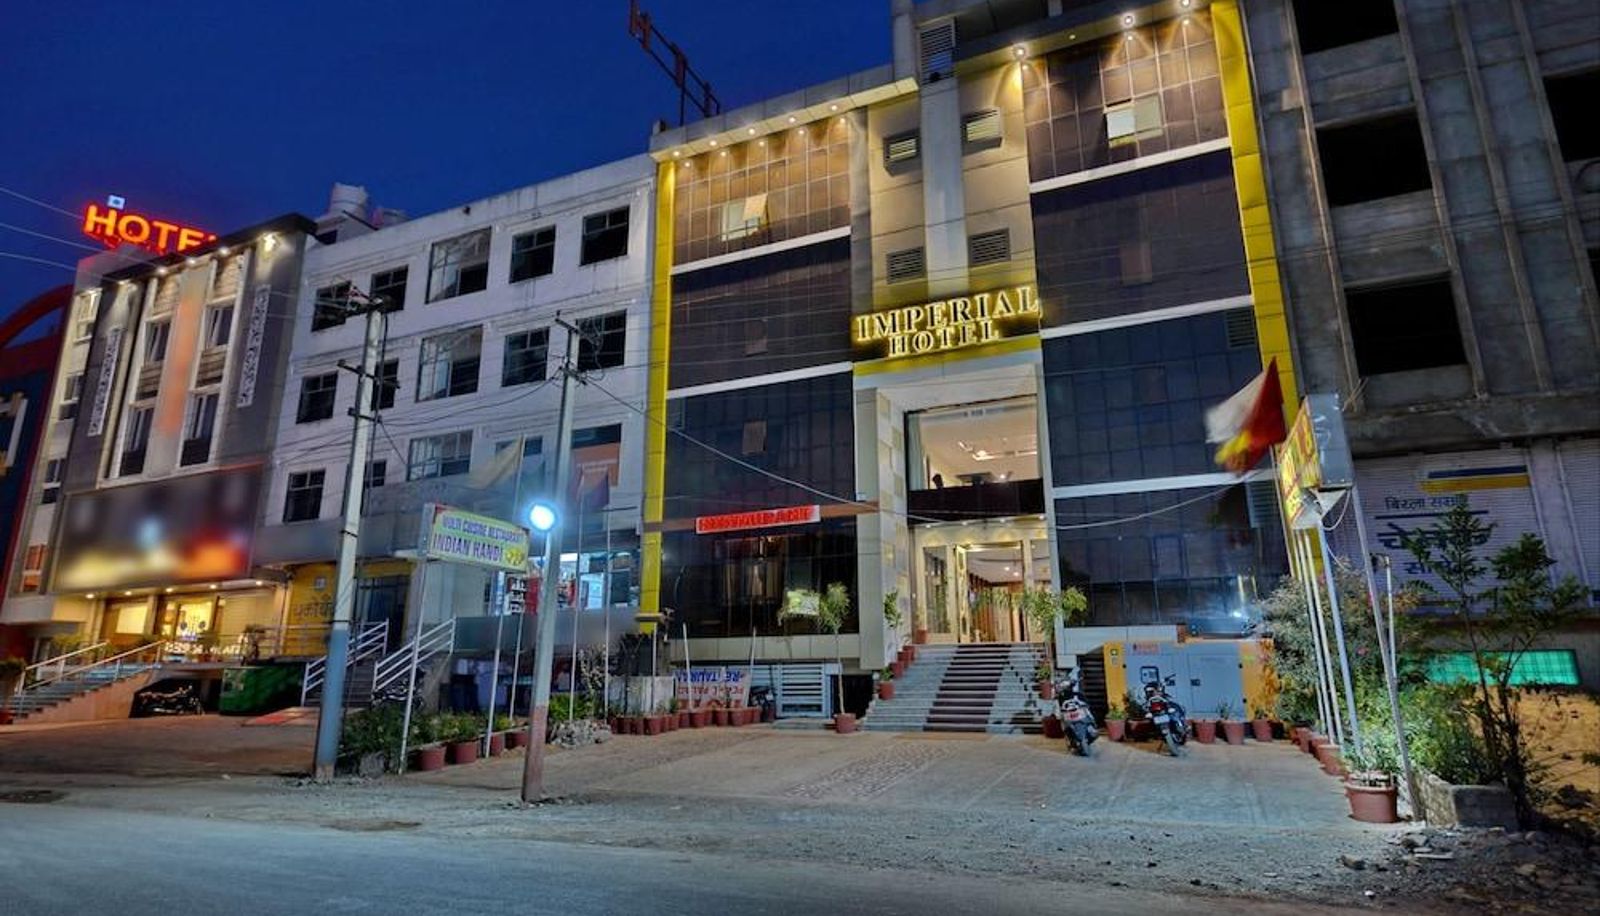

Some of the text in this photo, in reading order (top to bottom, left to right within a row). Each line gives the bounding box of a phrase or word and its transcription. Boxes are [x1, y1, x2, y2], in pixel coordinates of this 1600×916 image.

[84, 204, 217, 252] HOTE
[857, 285, 1040, 341] IMPERIAL
[887, 320, 999, 358] HOTEL
[433, 532, 469, 556] INDIAN
